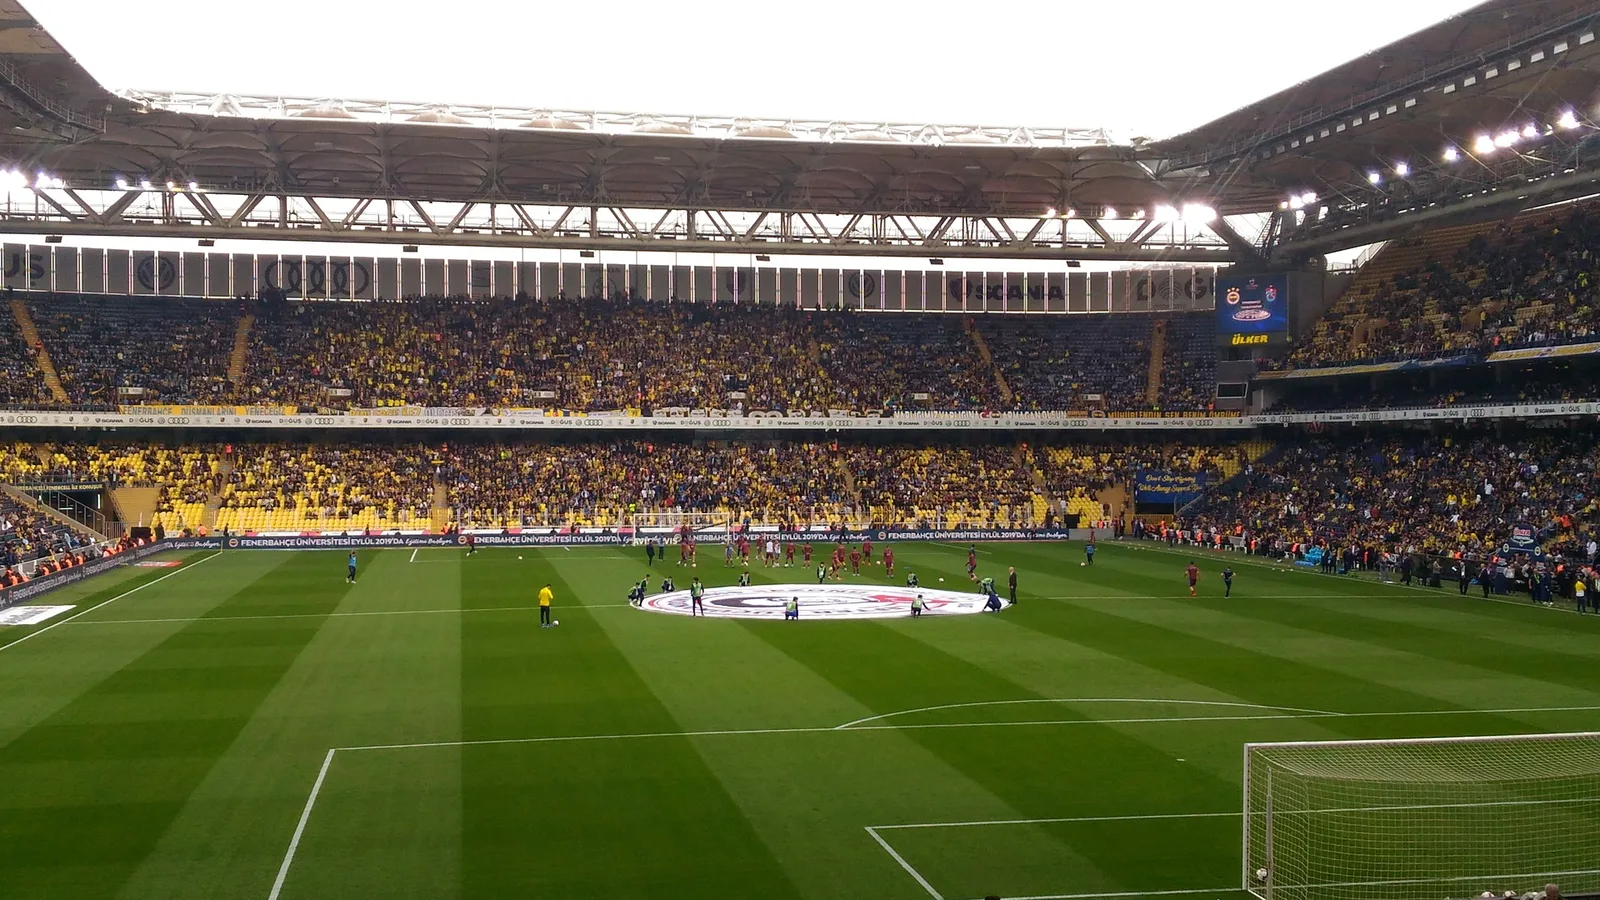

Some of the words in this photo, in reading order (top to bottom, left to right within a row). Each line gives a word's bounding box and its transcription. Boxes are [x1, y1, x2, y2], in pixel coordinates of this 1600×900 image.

[975, 284, 1065, 300] SCANIA
[1232, 334, 1268, 345] ÜLKER
[471, 536, 520, 545] ENERBAHÇE
[521, 534, 571, 543] ÜNİVERSİTESİ
[572, 535, 594, 543] EYLÜL
[781, 532, 802, 540] EYLÜL
[888, 533, 935, 541] FENERBAHÇE
[935, 531, 980, 539] ÜNİVERSİTESİ
[981, 531, 1001, 539] EYLÜL
[241, 538, 295, 547] FENERBAHÇE
[297, 537, 350, 546] ÜNİVERSİTESİ
[351, 537, 375, 545] EYLÜL
